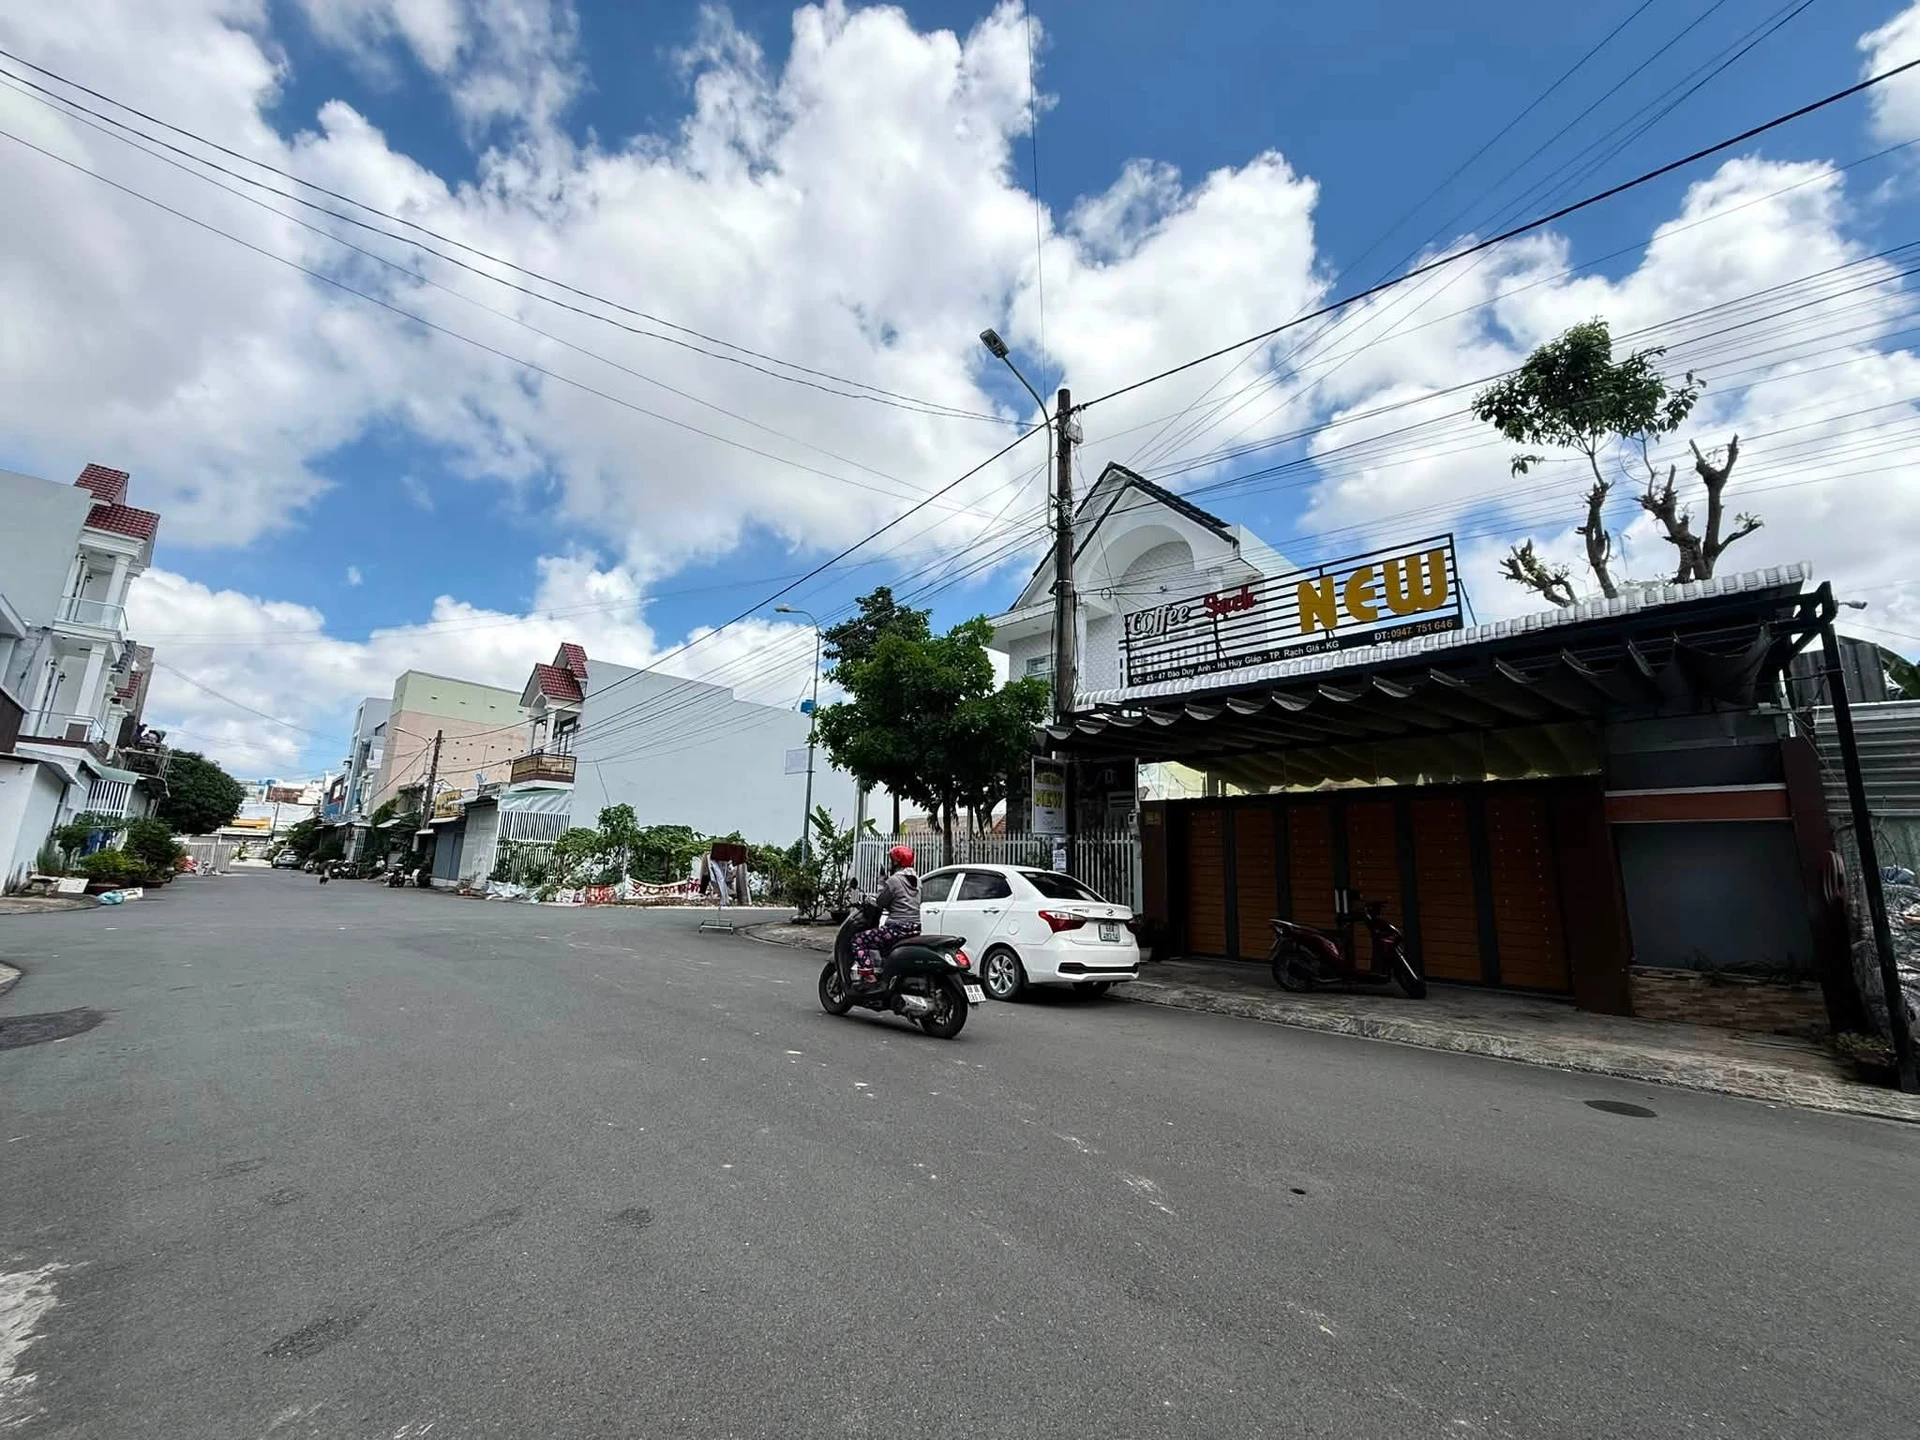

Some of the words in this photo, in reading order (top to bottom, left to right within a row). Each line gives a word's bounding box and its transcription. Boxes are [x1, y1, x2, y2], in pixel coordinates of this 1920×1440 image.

[1297, 550, 1449, 634] NEW
[1129, 604, 1190, 636] Coffee
[1416, 623, 1432, 633] 751
[1434, 619, 1453, 630] 646
[1181, 667, 1195, 676] Duy
[1197, 664, 1211, 672] Anh
[1228, 658, 1243, 667] Huy
[1269, 651, 1281, 660] TP.
[1325, 640, 1340, 650] KG
